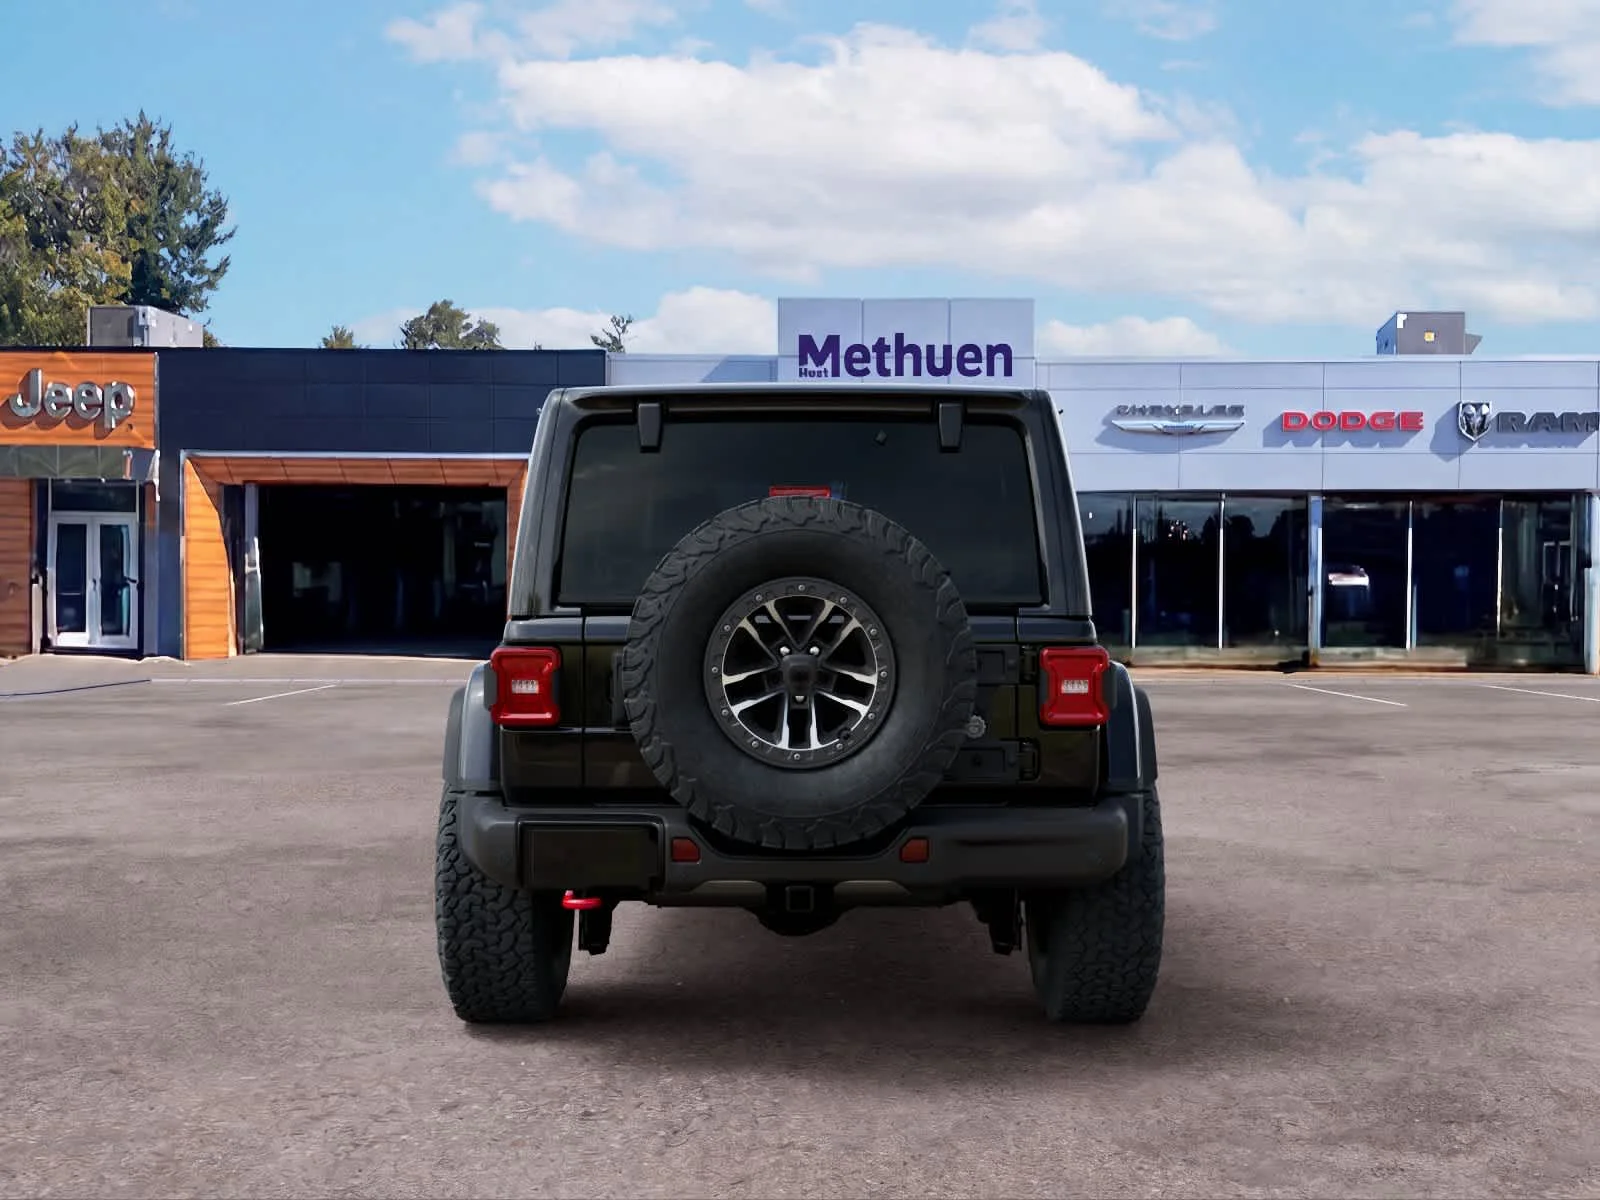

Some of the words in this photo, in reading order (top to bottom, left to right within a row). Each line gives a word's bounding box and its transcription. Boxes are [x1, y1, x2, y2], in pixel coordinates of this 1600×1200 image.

[799, 333, 1013, 378] Methuen
[9, 368, 136, 429] Jeep
[1283, 411, 1424, 431] DODGE
[1497, 411, 1600, 432] RAM
